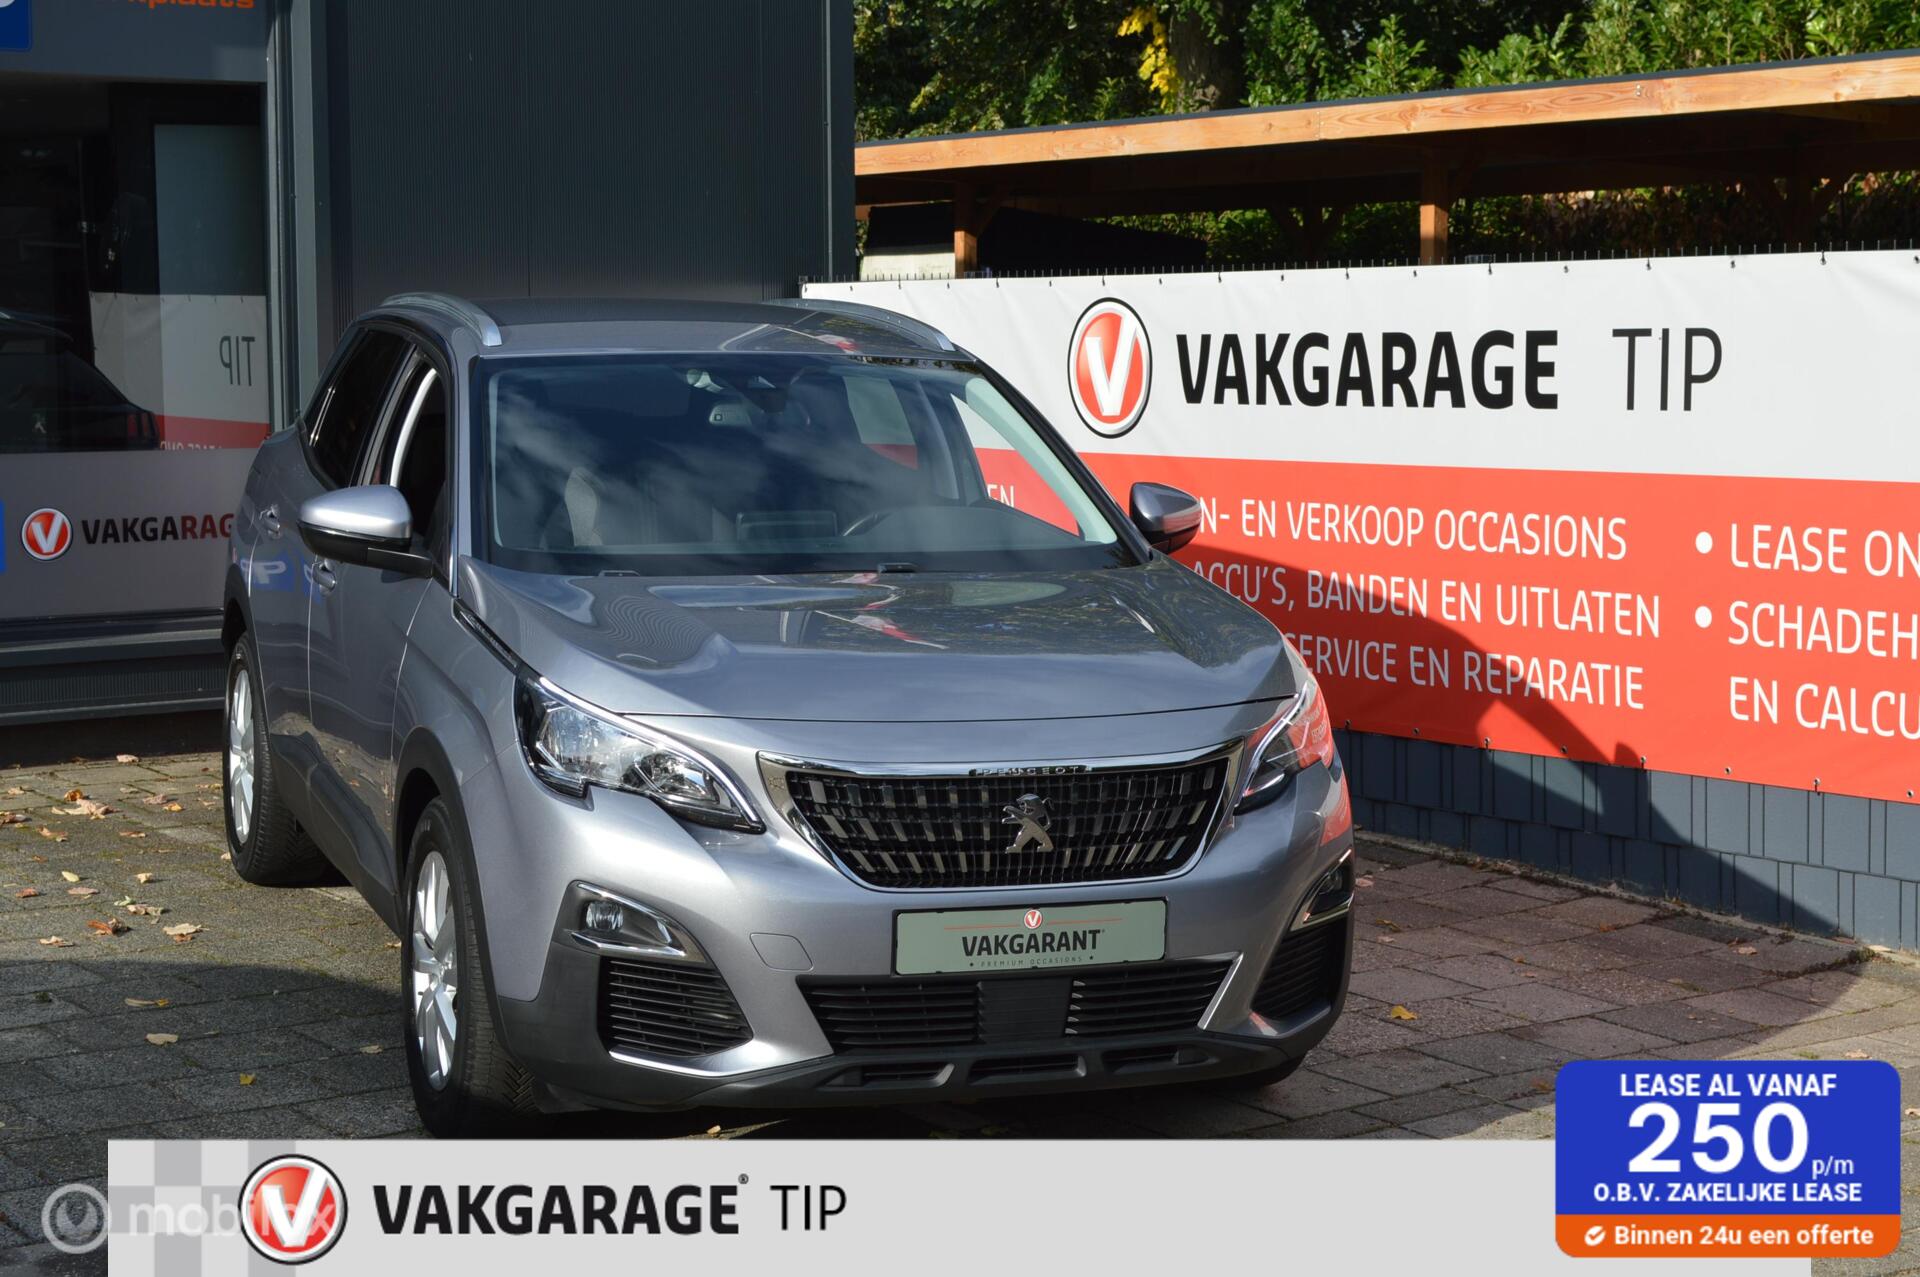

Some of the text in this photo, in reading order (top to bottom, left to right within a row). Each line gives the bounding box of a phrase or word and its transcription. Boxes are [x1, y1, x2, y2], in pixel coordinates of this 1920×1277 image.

[1176, 327, 1723, 411] VAKGARAGE TIP
[1241, 498, 1277, 539] EN
[1286, 501, 1424, 547] VERKOOP
[1434, 509, 1627, 561] OCCASIONS
[1731, 523, 1848, 574] LEASE
[1307, 570, 1428, 618] BANDEN
[1441, 580, 1481, 624] EN
[1496, 583, 1660, 639] UITLATEN
[1728, 600, 1918, 661] SCHADEH
[1284, 633, 1644, 710] ERVICE EN REPARATIE
[1730, 676, 1920, 740] EN CALCU
[982, 765, 1080, 777] PEUGEOT
[961, 929, 1101, 957] VAKGARANT
